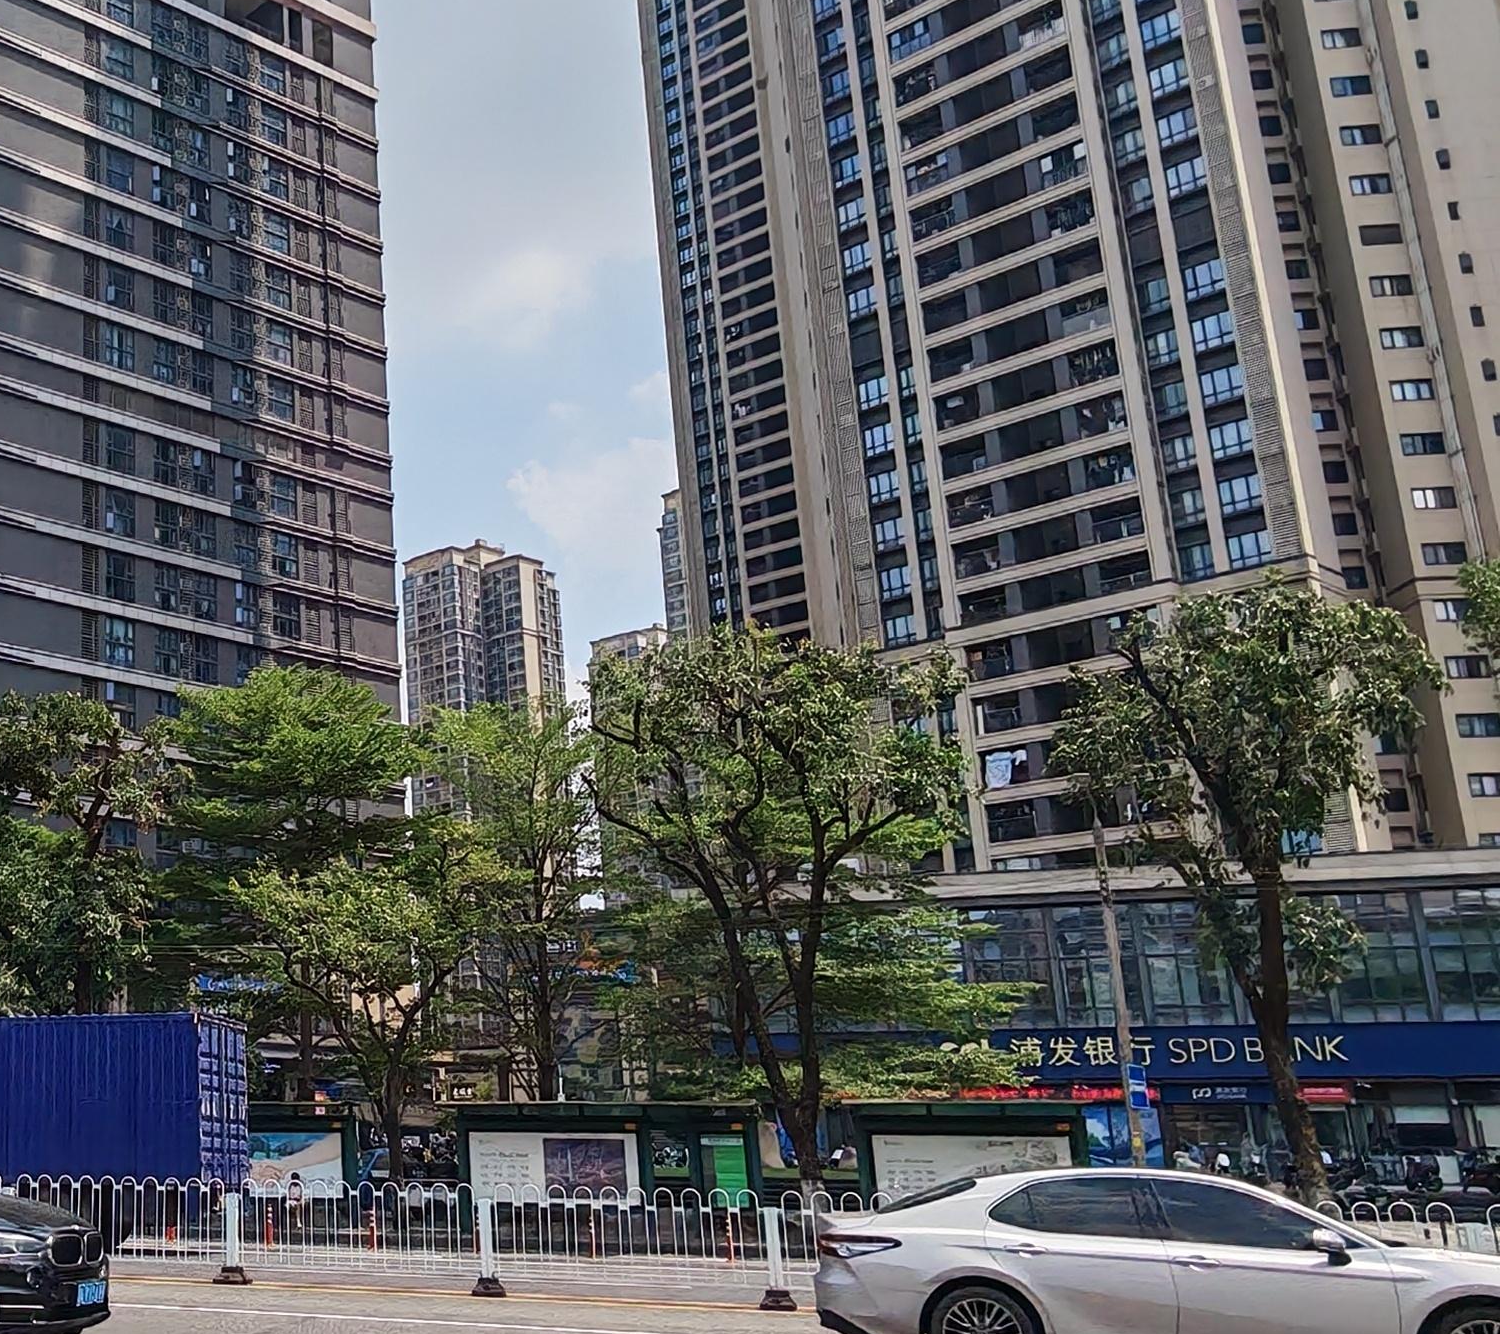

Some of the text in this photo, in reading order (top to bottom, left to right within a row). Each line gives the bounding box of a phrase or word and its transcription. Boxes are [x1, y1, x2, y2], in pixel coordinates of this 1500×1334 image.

[1010, 1035, 1349, 1066] 浦发银行 SPD BNK
